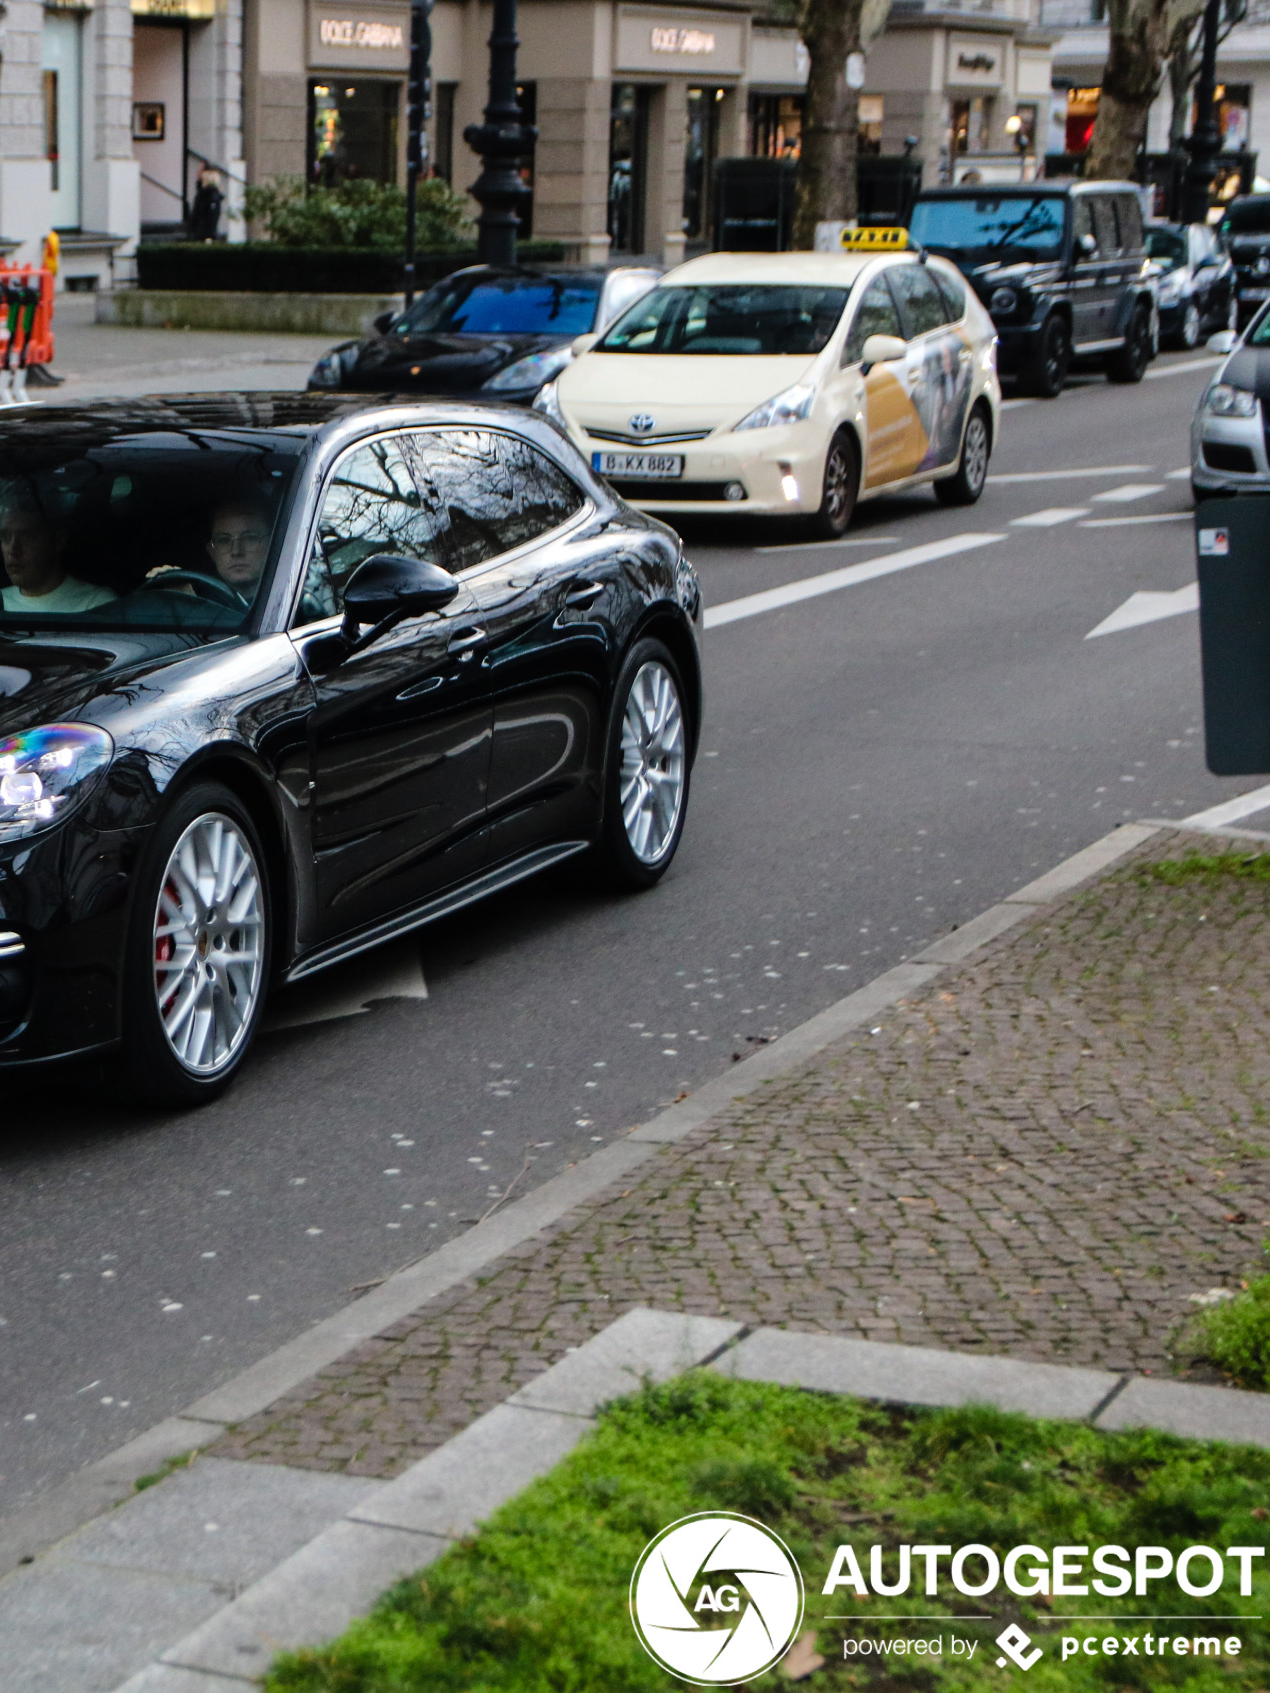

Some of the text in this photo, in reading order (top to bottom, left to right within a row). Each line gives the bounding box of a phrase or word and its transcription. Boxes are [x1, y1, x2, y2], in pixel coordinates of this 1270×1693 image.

[849, 229, 894, 242] TAXI
[606, 454, 616, 470] B
[648, 456, 675, 472] 882
